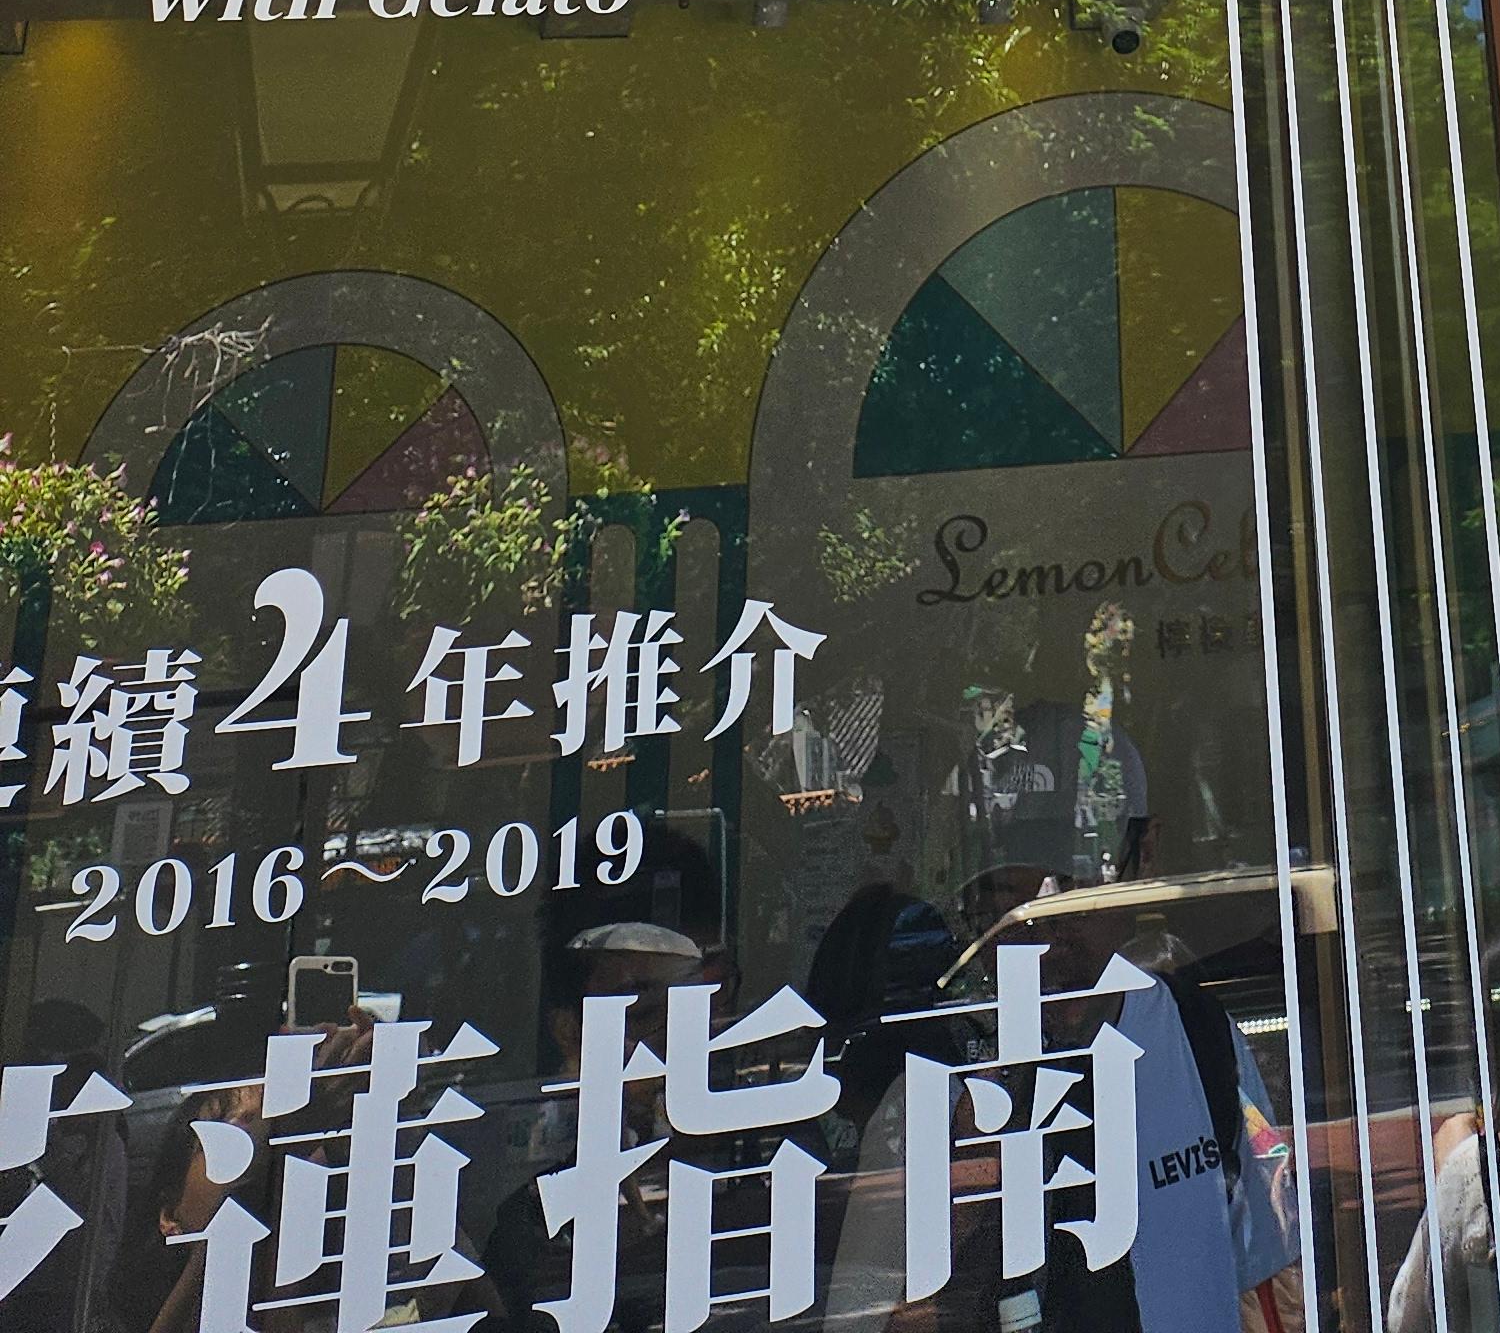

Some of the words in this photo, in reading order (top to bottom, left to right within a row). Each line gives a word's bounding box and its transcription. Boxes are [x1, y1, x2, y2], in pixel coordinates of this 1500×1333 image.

[0, 567, 828, 808] 續4年推介
[1148, 1136, 1221, 1190] LEVI'S
